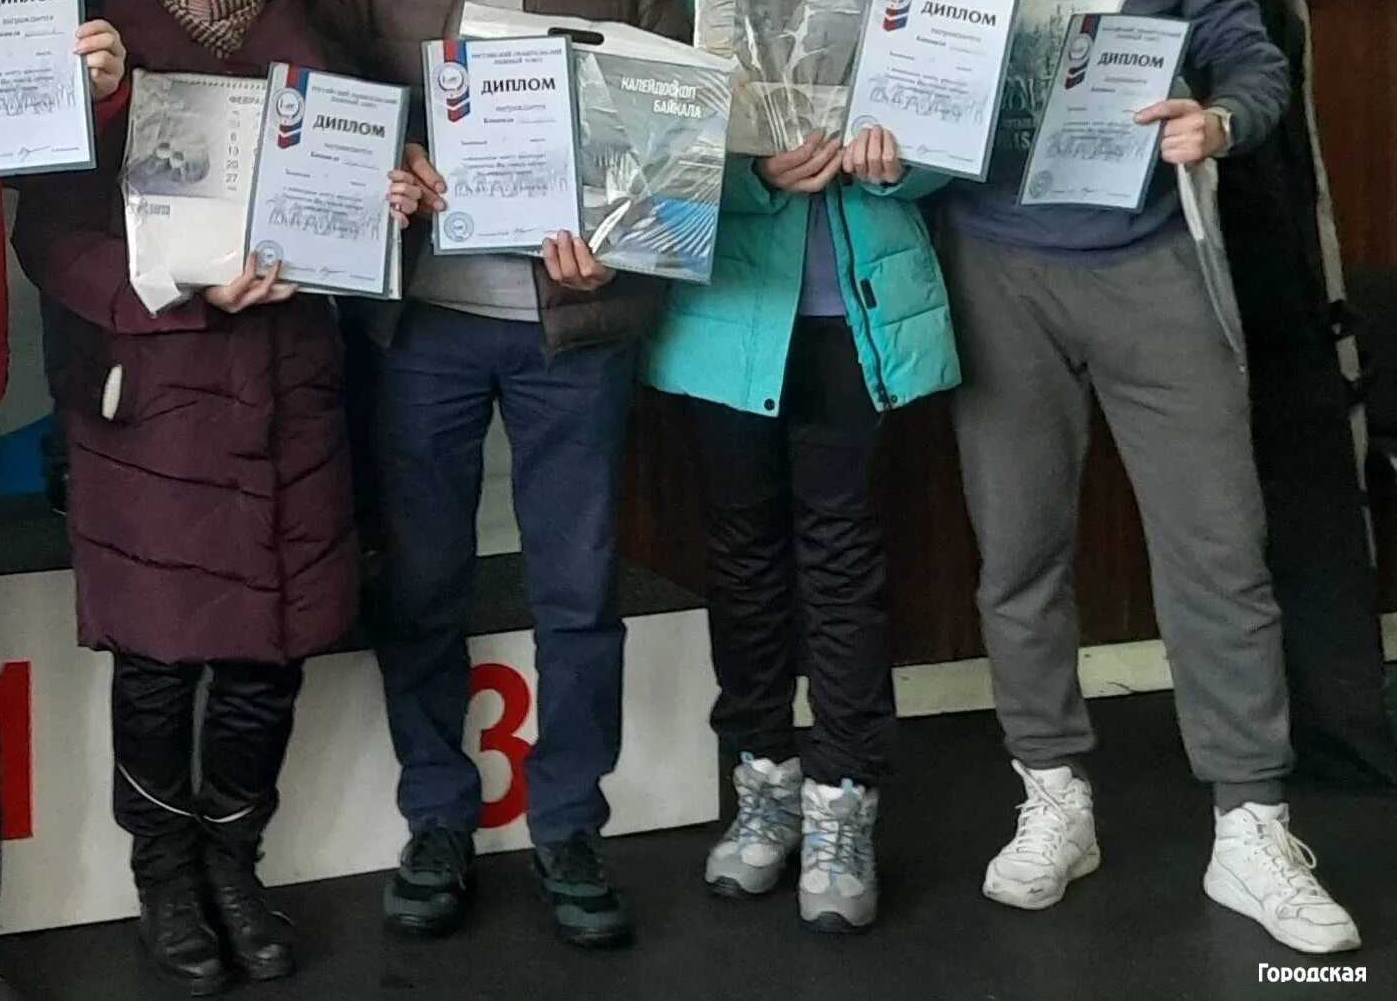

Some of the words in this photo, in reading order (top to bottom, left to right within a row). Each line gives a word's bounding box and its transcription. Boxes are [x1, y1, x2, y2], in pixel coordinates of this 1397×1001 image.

[920, 0, 997, 27] ДИПЛОМ
[1096, 51, 1165, 69] ДИПЛОМ
[481, 77, 557, 96] ДИПЛОМ
[620, 77, 697, 100] КАЛЕЙДОСКОП
[229, 95, 264, 105] ФЕВРА
[653, 99, 702, 118] БАЙКАЛА
[312, 114, 386, 139] ДИПЛОМ
[226, 160, 239, 169] 20
[225, 173, 239, 183] 27
[465, 663, 539, 830] 3
